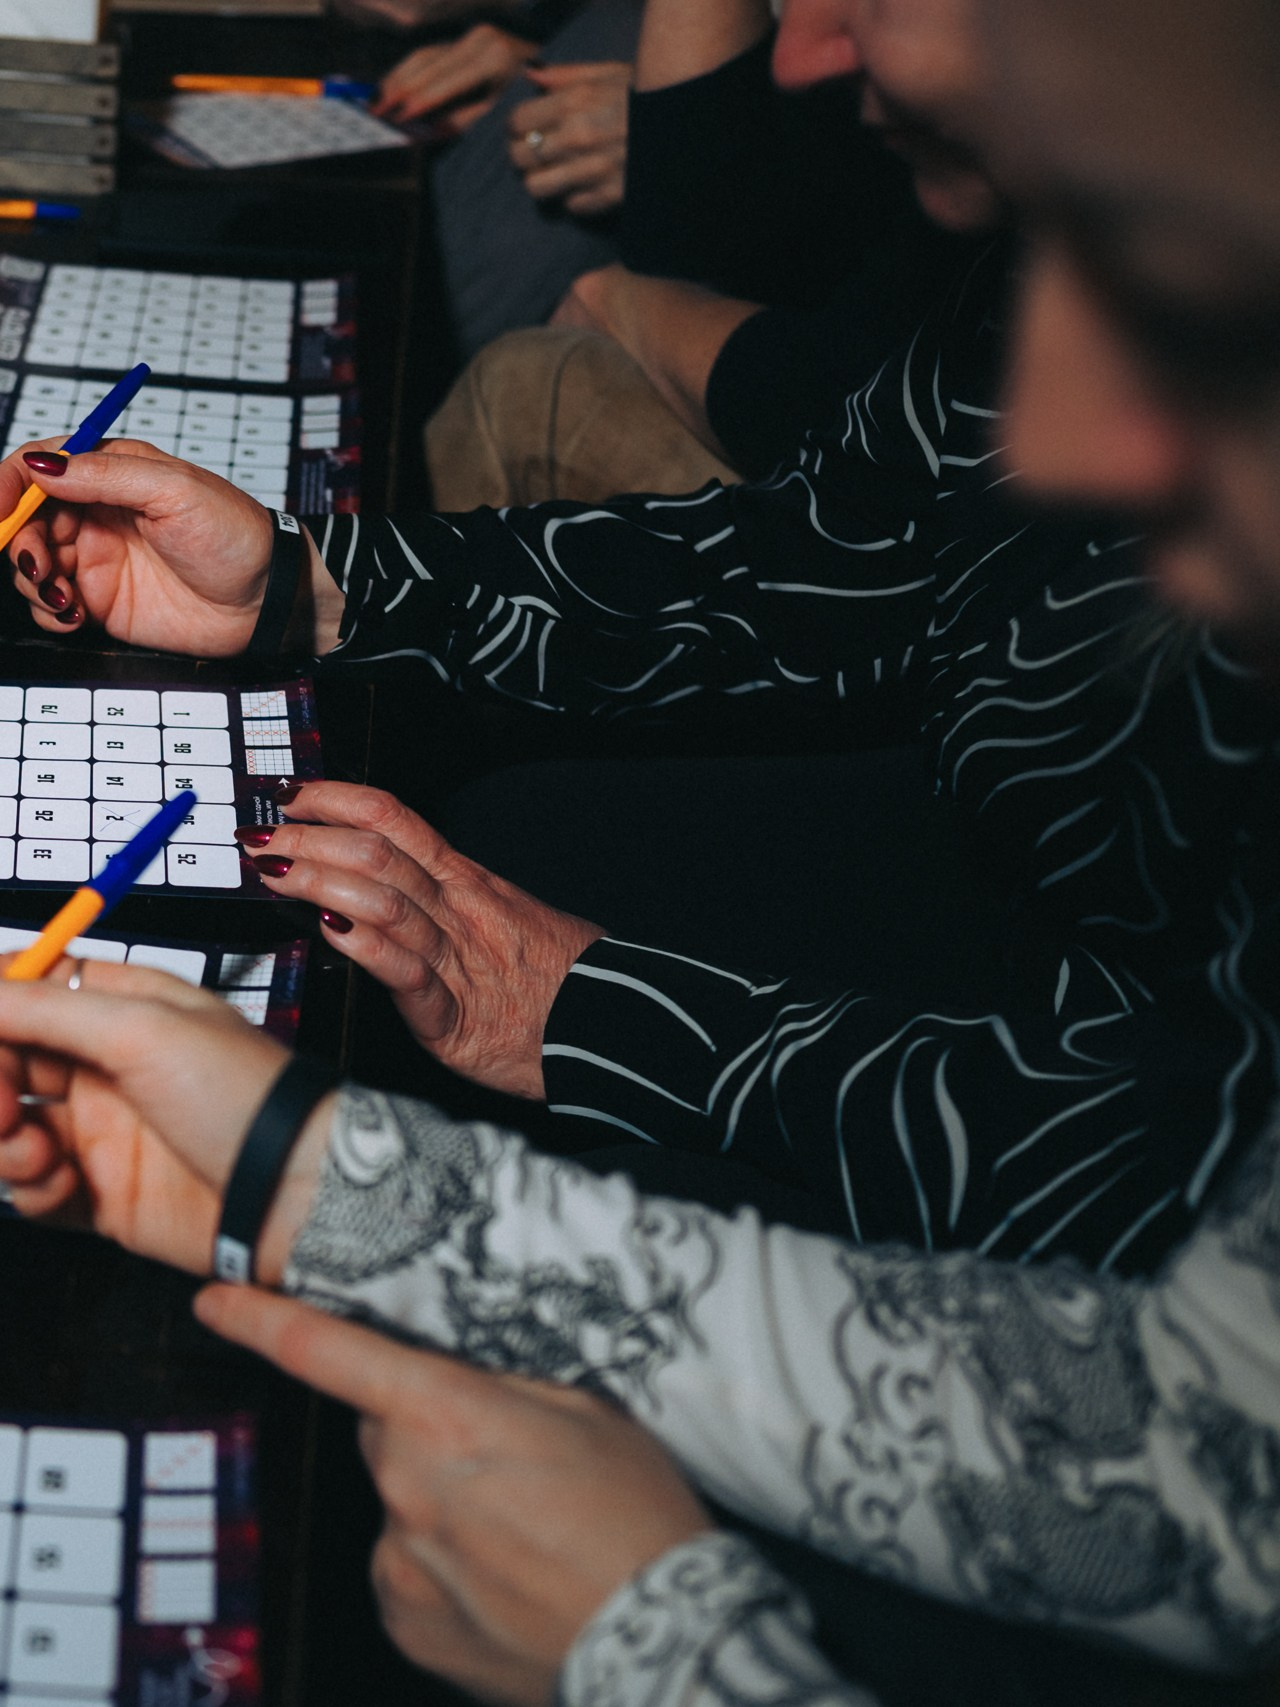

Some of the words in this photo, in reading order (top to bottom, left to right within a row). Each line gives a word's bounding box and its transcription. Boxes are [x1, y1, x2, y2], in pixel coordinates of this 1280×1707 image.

[40, 704, 58, 714] 79
[107, 707, 124, 716] 52
[106, 741, 124, 750] 13
[173, 743, 192, 754] 86
[37, 774, 55, 784] 16
[106, 776, 124, 787] 14
[174, 778, 194, 790] 64
[34, 810, 54, 822] 26
[33, 848, 52, 860] 33
[177, 853, 197, 865] 25
